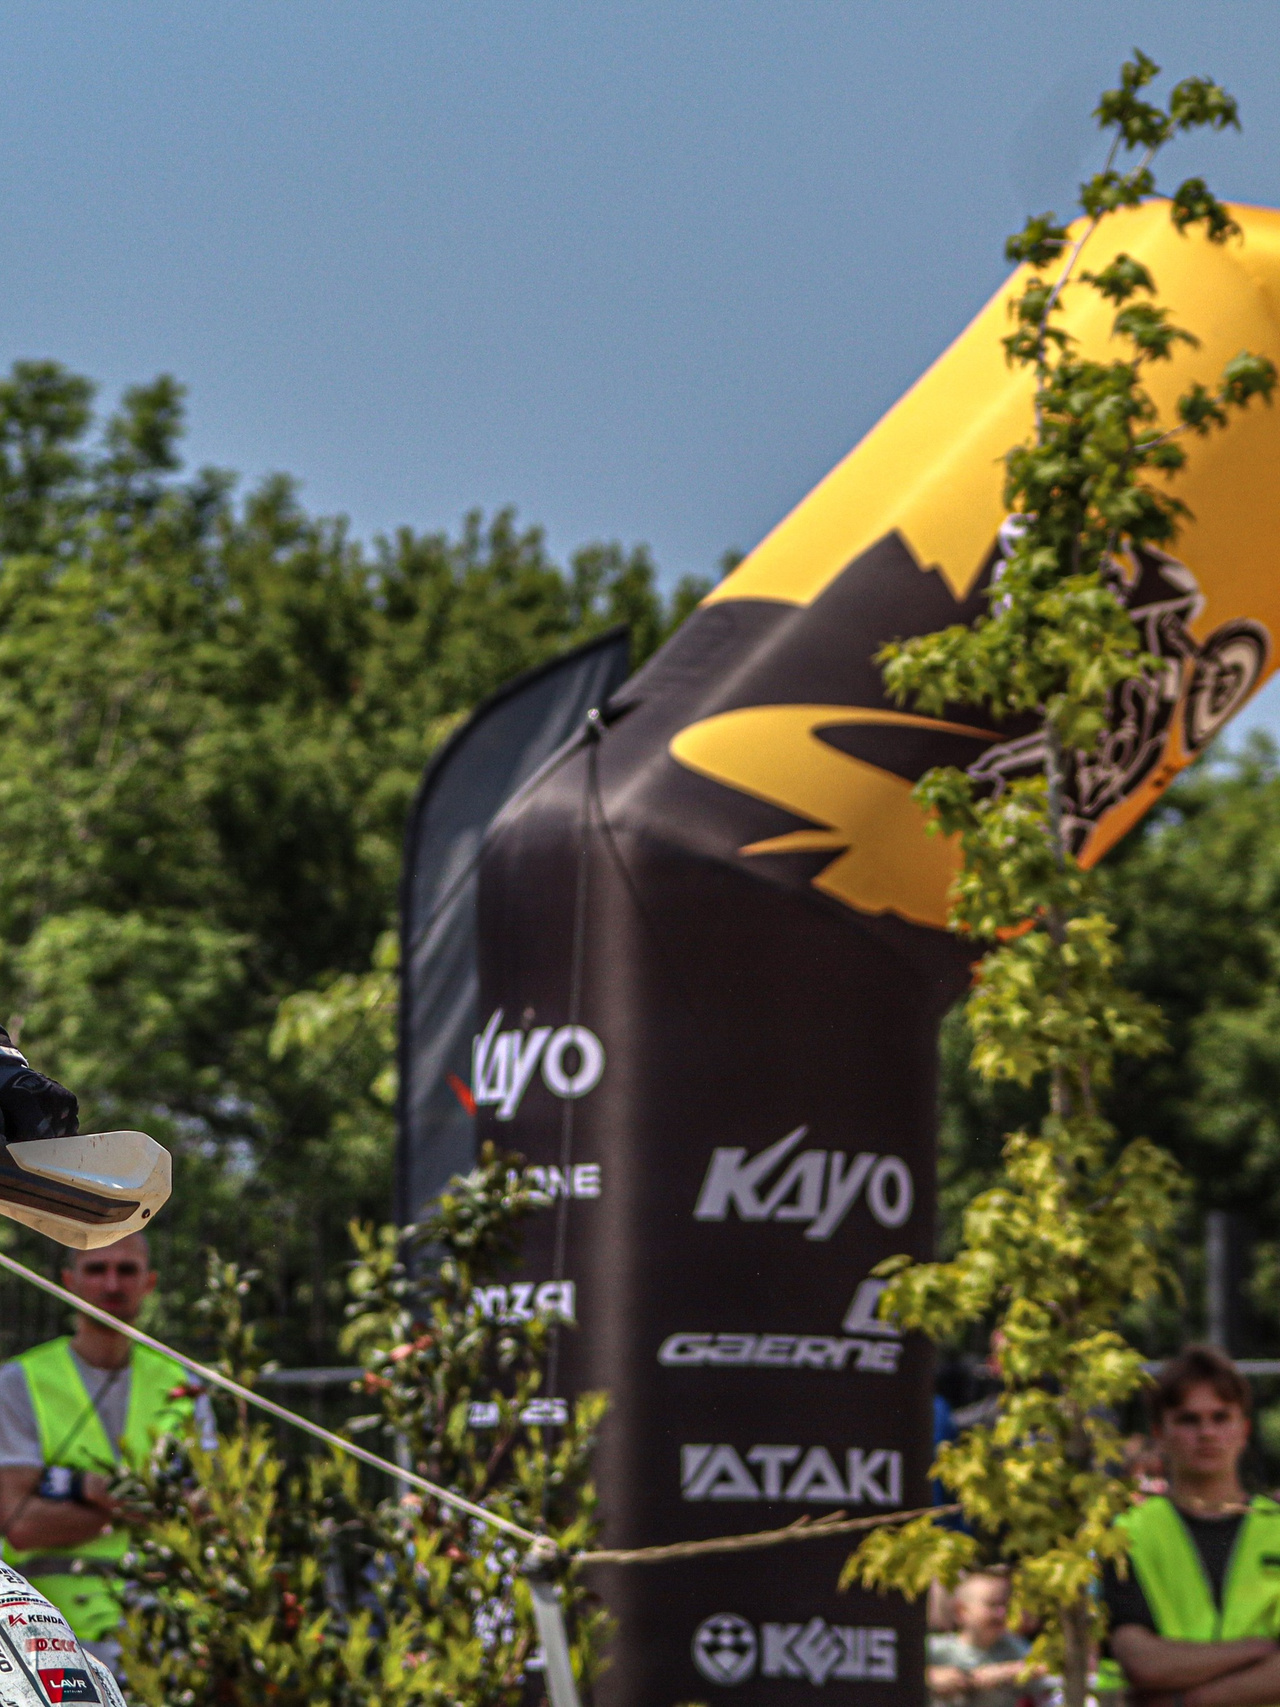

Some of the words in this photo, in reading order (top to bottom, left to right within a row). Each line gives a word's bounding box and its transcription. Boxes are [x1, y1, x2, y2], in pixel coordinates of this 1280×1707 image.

[692, 1124, 914, 1241] KAYO
[28, 1614, 65, 1626] KENDA
[50, 1676, 88, 1690] LAVR
